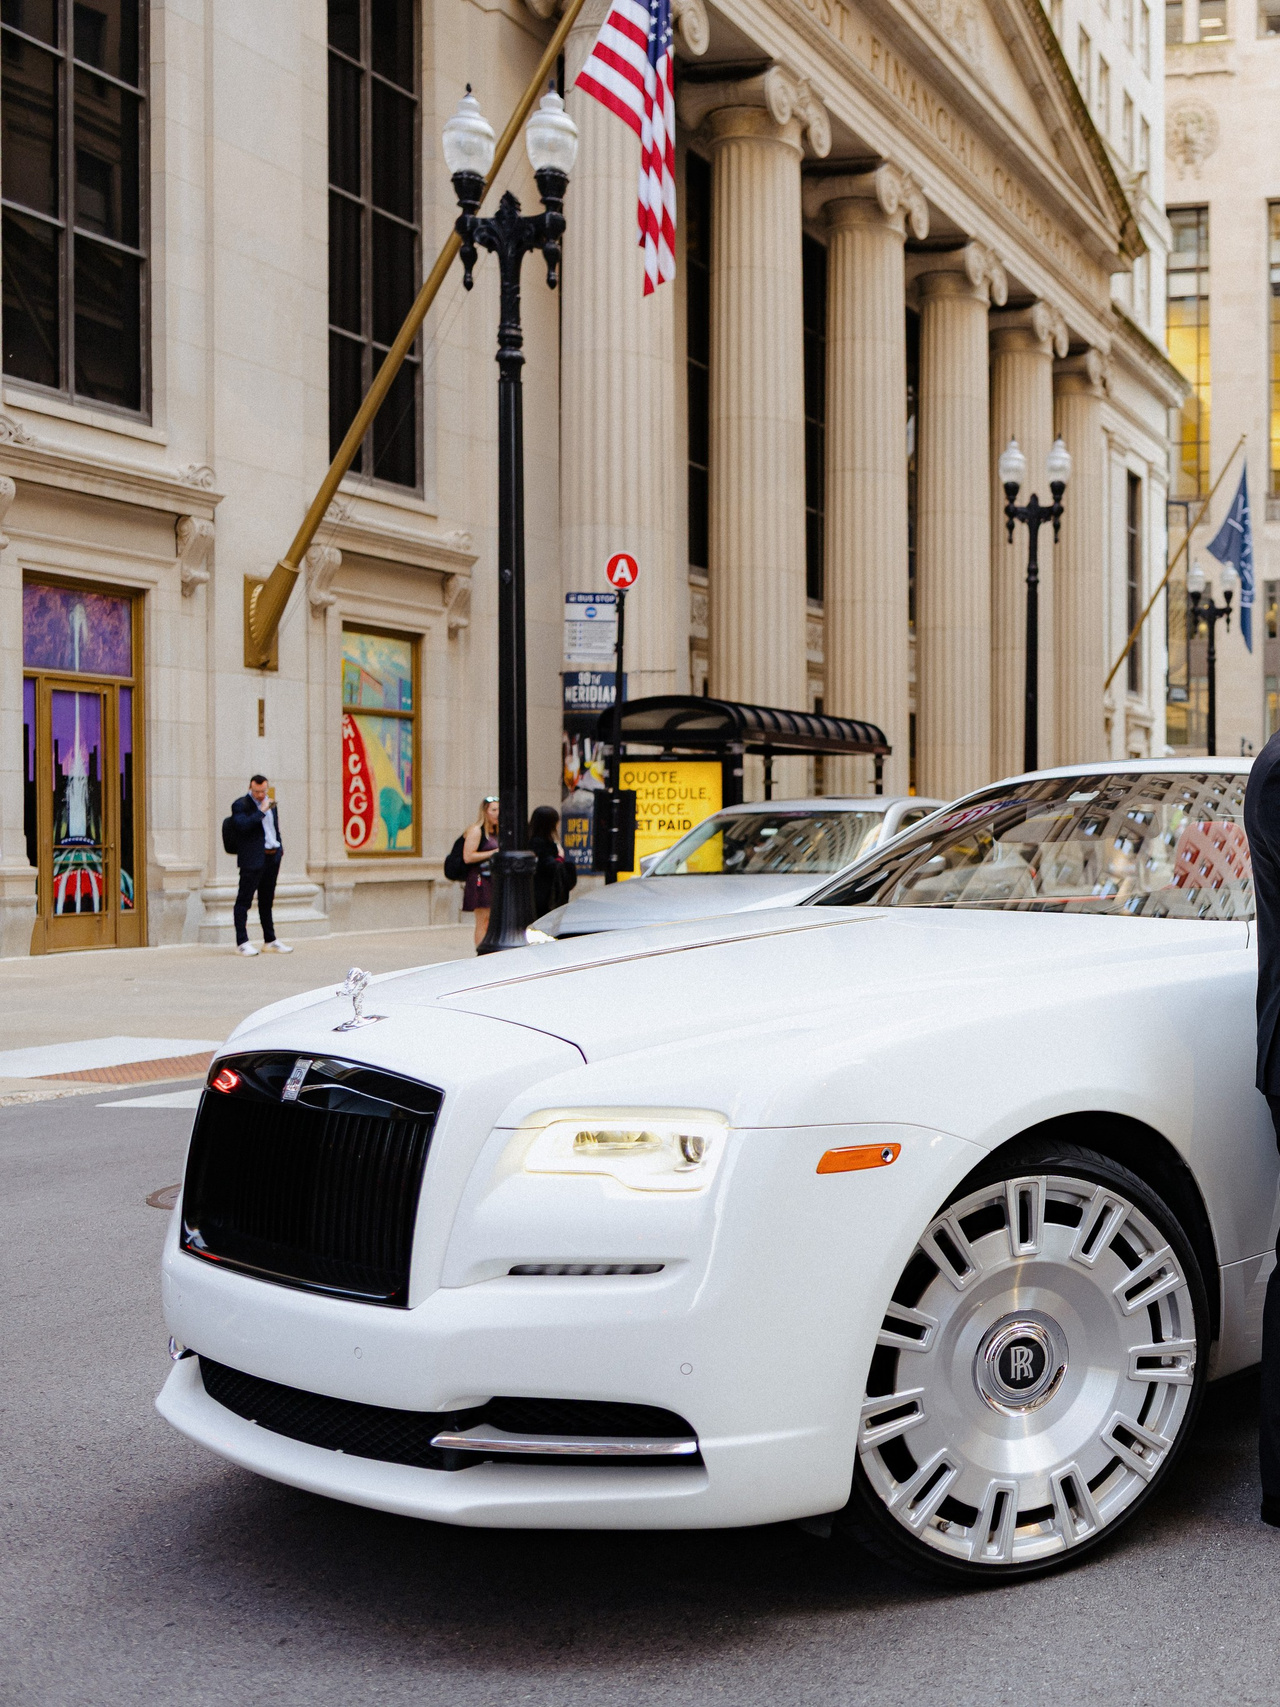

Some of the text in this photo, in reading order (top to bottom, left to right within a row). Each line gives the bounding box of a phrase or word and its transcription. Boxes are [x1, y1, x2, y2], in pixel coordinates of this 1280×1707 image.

[869, 36, 979, 178] FINANCIAL
[611, 558, 633, 583] A
[577, 594, 616, 603] BUS STOP
[341, 713, 368, 847] CHICAGO
[637, 820, 692, 830] ET PAID
